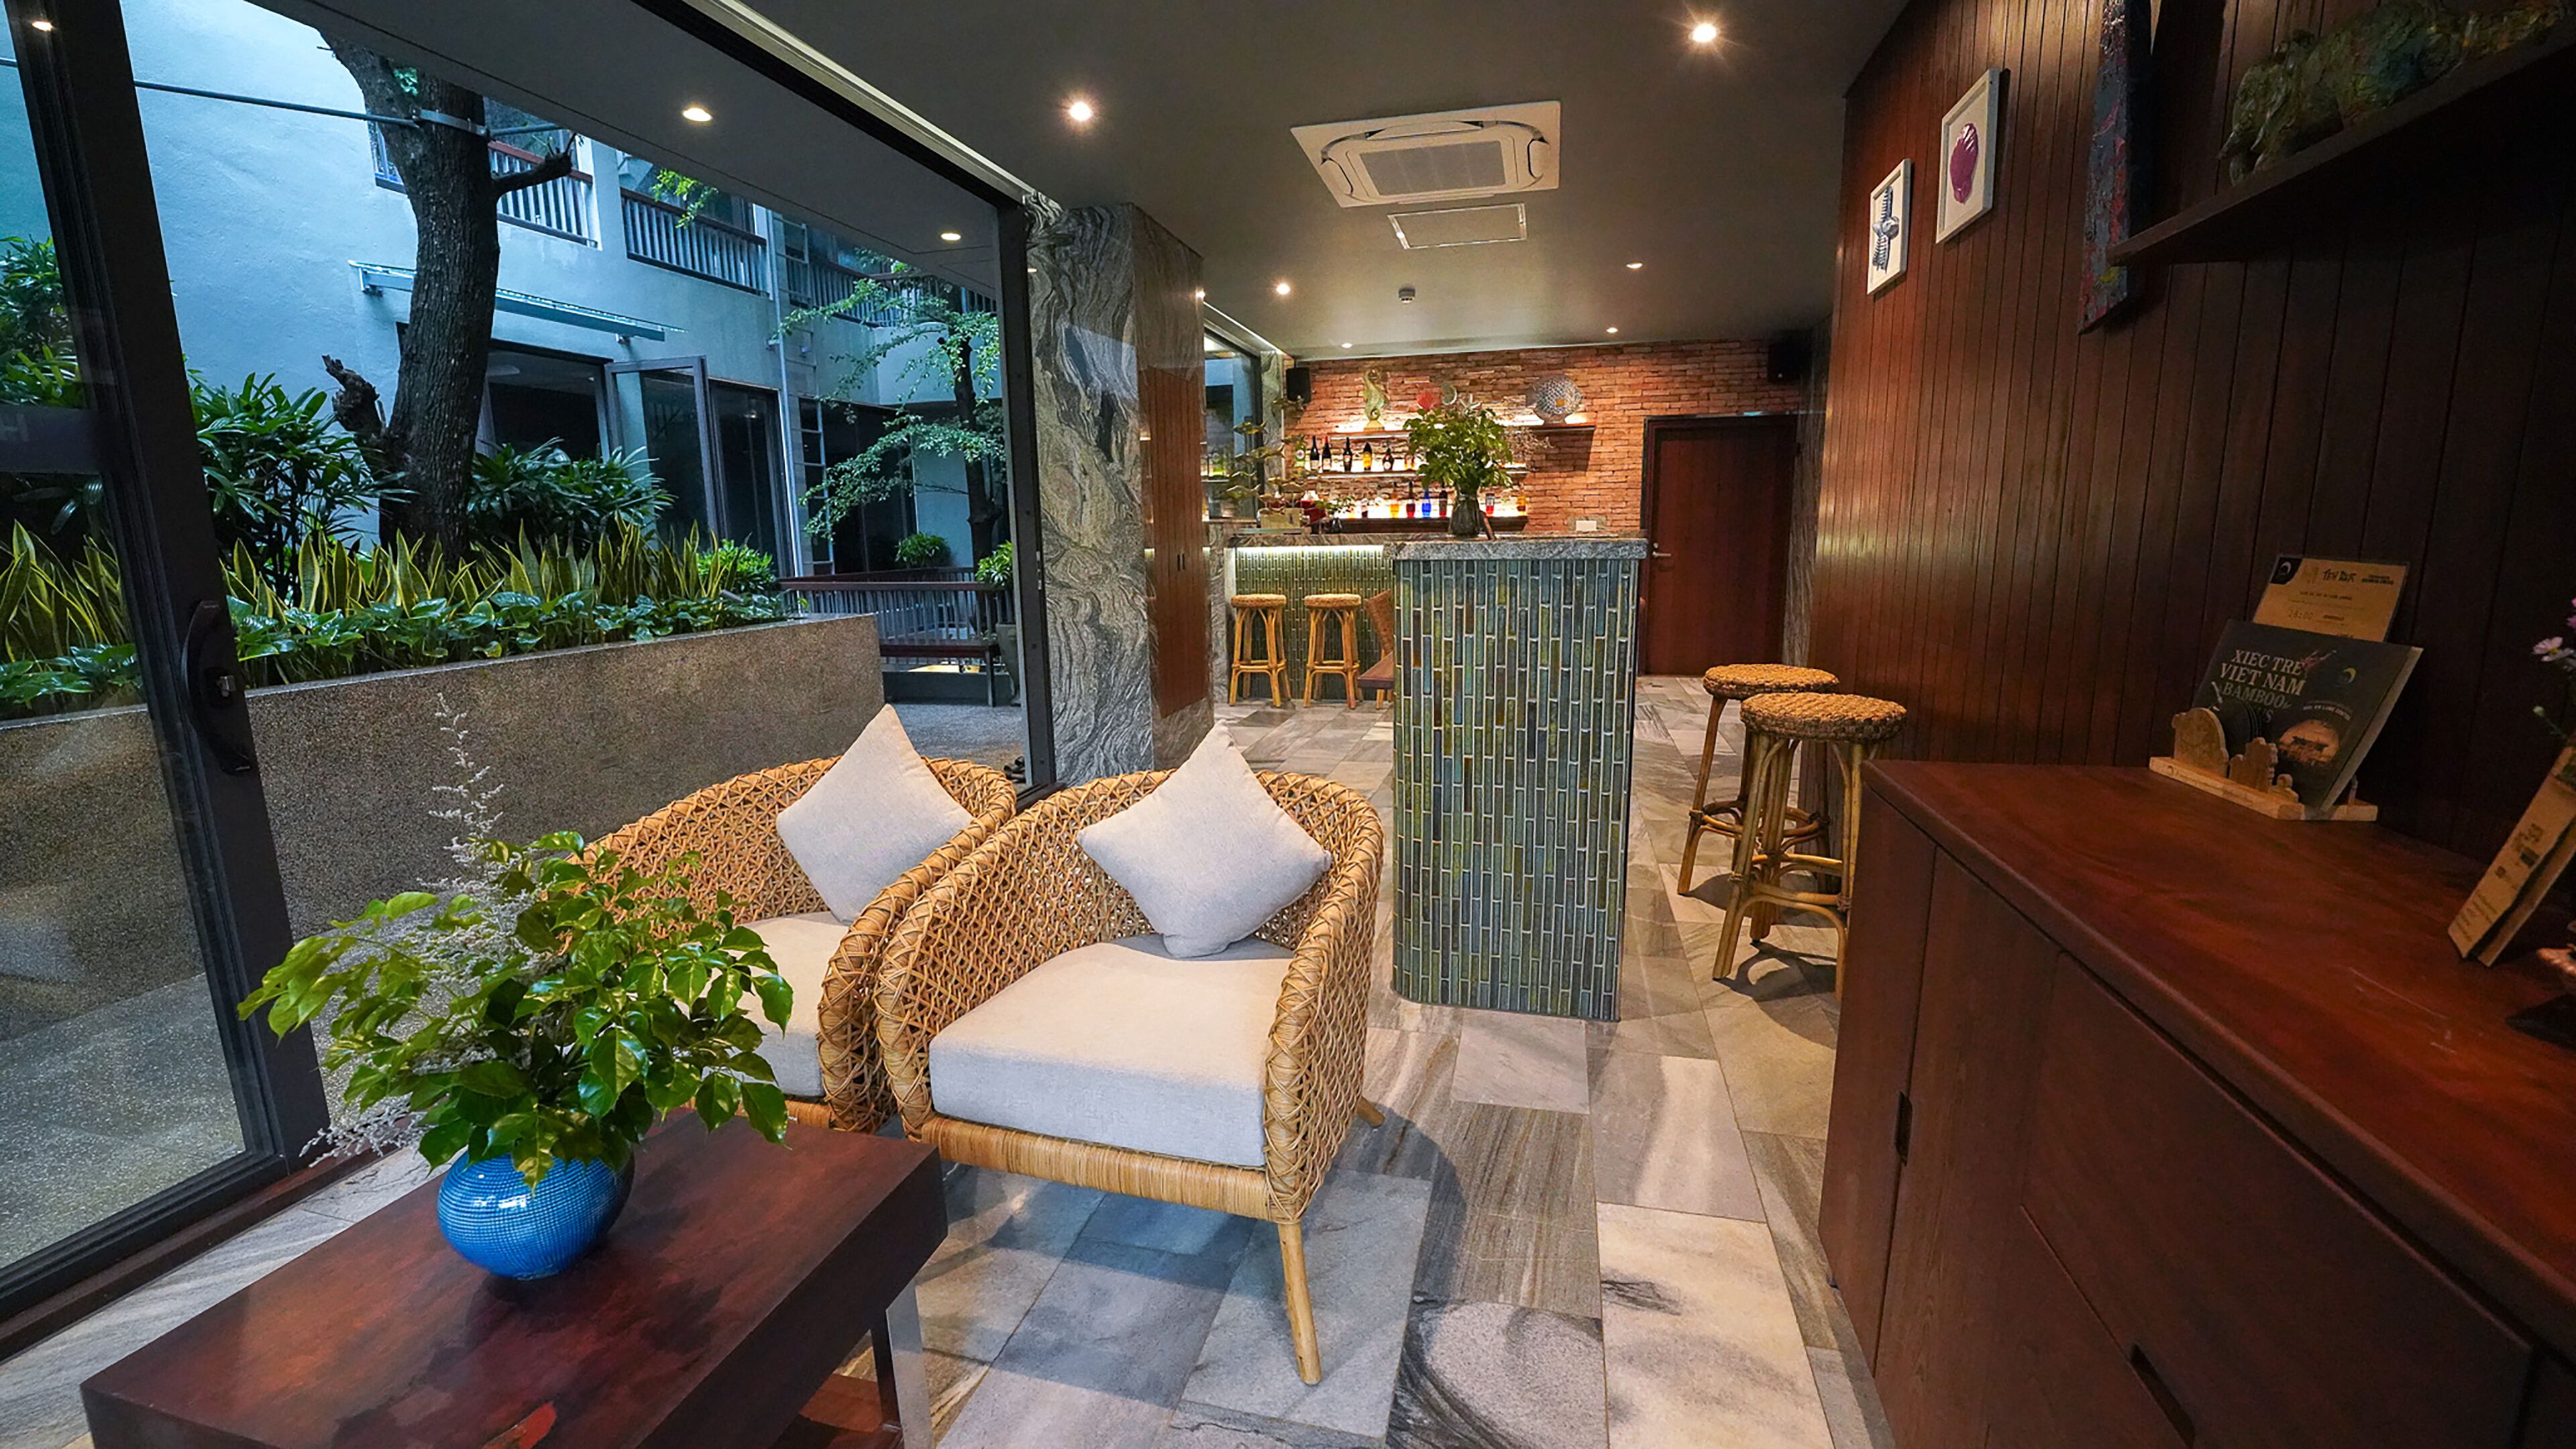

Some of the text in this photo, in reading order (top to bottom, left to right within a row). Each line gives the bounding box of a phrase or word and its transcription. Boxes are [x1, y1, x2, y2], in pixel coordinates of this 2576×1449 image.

[2272, 656, 2306, 676] TRE
[2222, 682, 2286, 708] BAMBOO
[2261, 672, 2306, 696] NAM
